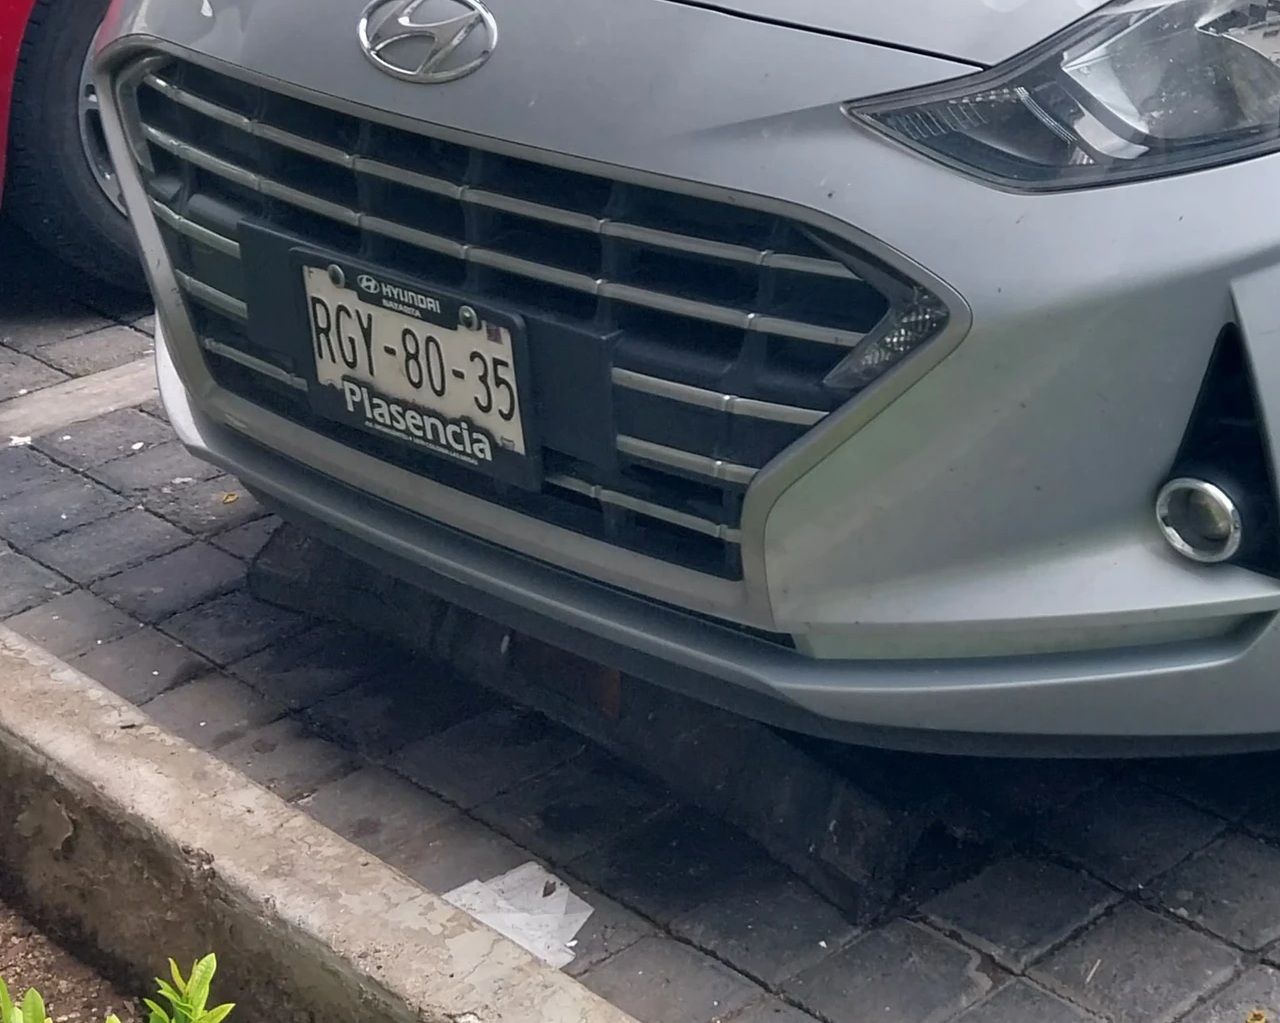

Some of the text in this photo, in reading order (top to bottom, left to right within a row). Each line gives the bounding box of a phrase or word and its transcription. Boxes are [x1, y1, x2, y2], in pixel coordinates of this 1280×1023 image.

[381, 282, 441, 313] HYUNDAI
[311, 296, 515, 421] RGY-80-35
[343, 381, 492, 462] Plasencia
